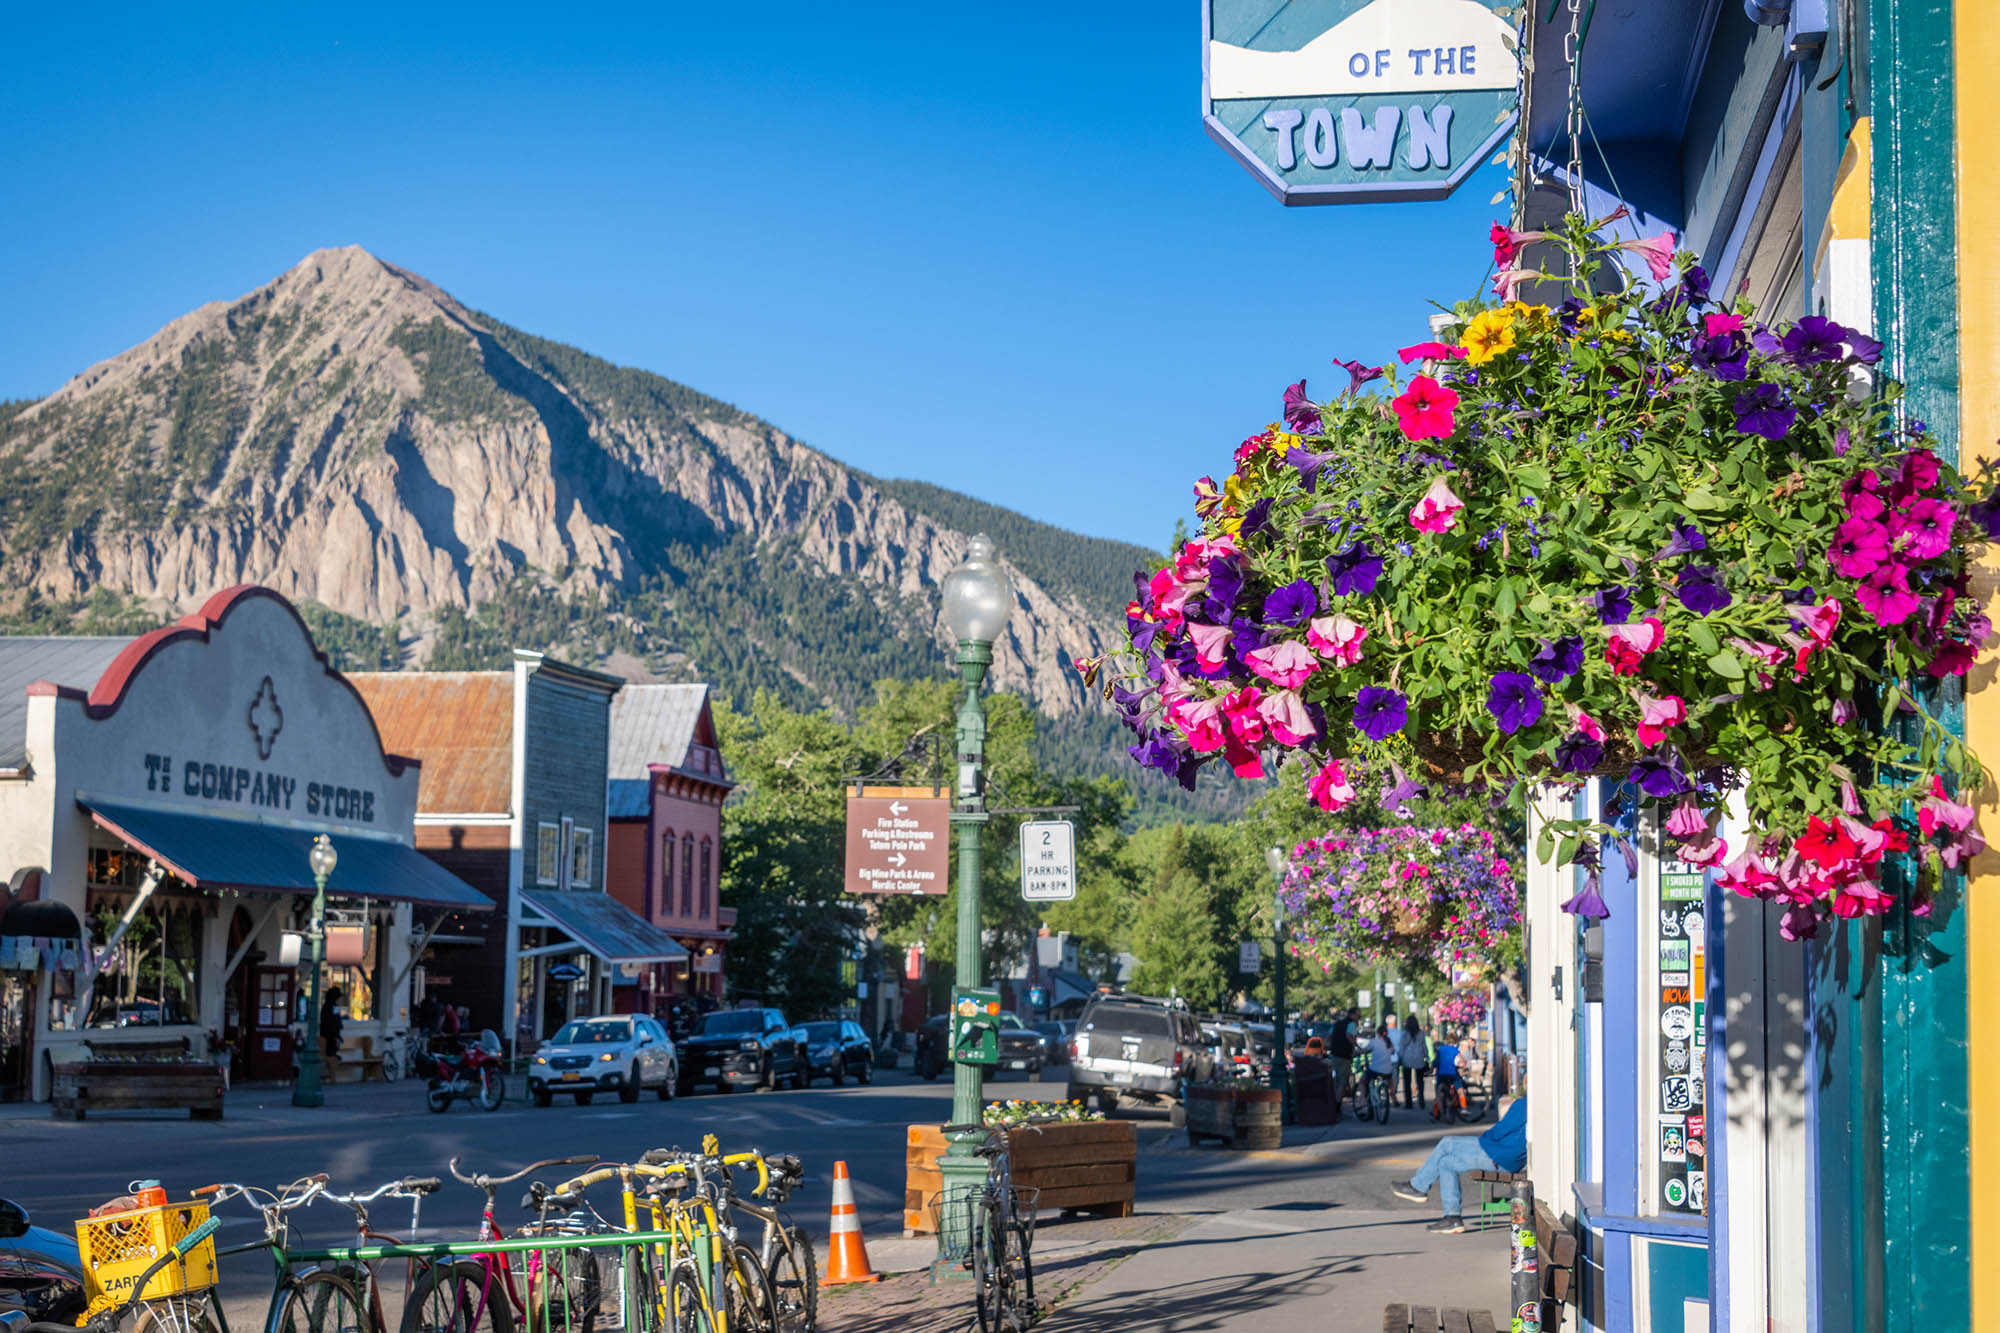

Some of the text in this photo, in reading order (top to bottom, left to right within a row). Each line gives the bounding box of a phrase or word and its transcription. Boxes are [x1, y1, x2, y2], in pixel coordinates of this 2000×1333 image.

[1349, 45, 1476, 78] OF THE
[1263, 104, 1454, 171] TOWN
[184, 761, 296, 810] COMPANY
[306, 782, 375, 822] STORE
[878, 817, 919, 828] Fire Station
[862, 829, 890, 841] Parking
[896, 829, 934, 839] Restrooms
[1042, 831, 1051, 845] 2
[870, 840, 926, 850] Totem Pole Park
[1041, 851, 1054, 861] HR
[859, 868, 935, 881] Big Mine Park & Arena
[1027, 865, 1068, 876] PARKING
[872, 880, 920, 890] Nordic Center
[104, 1274, 152, 1292] ZARD
